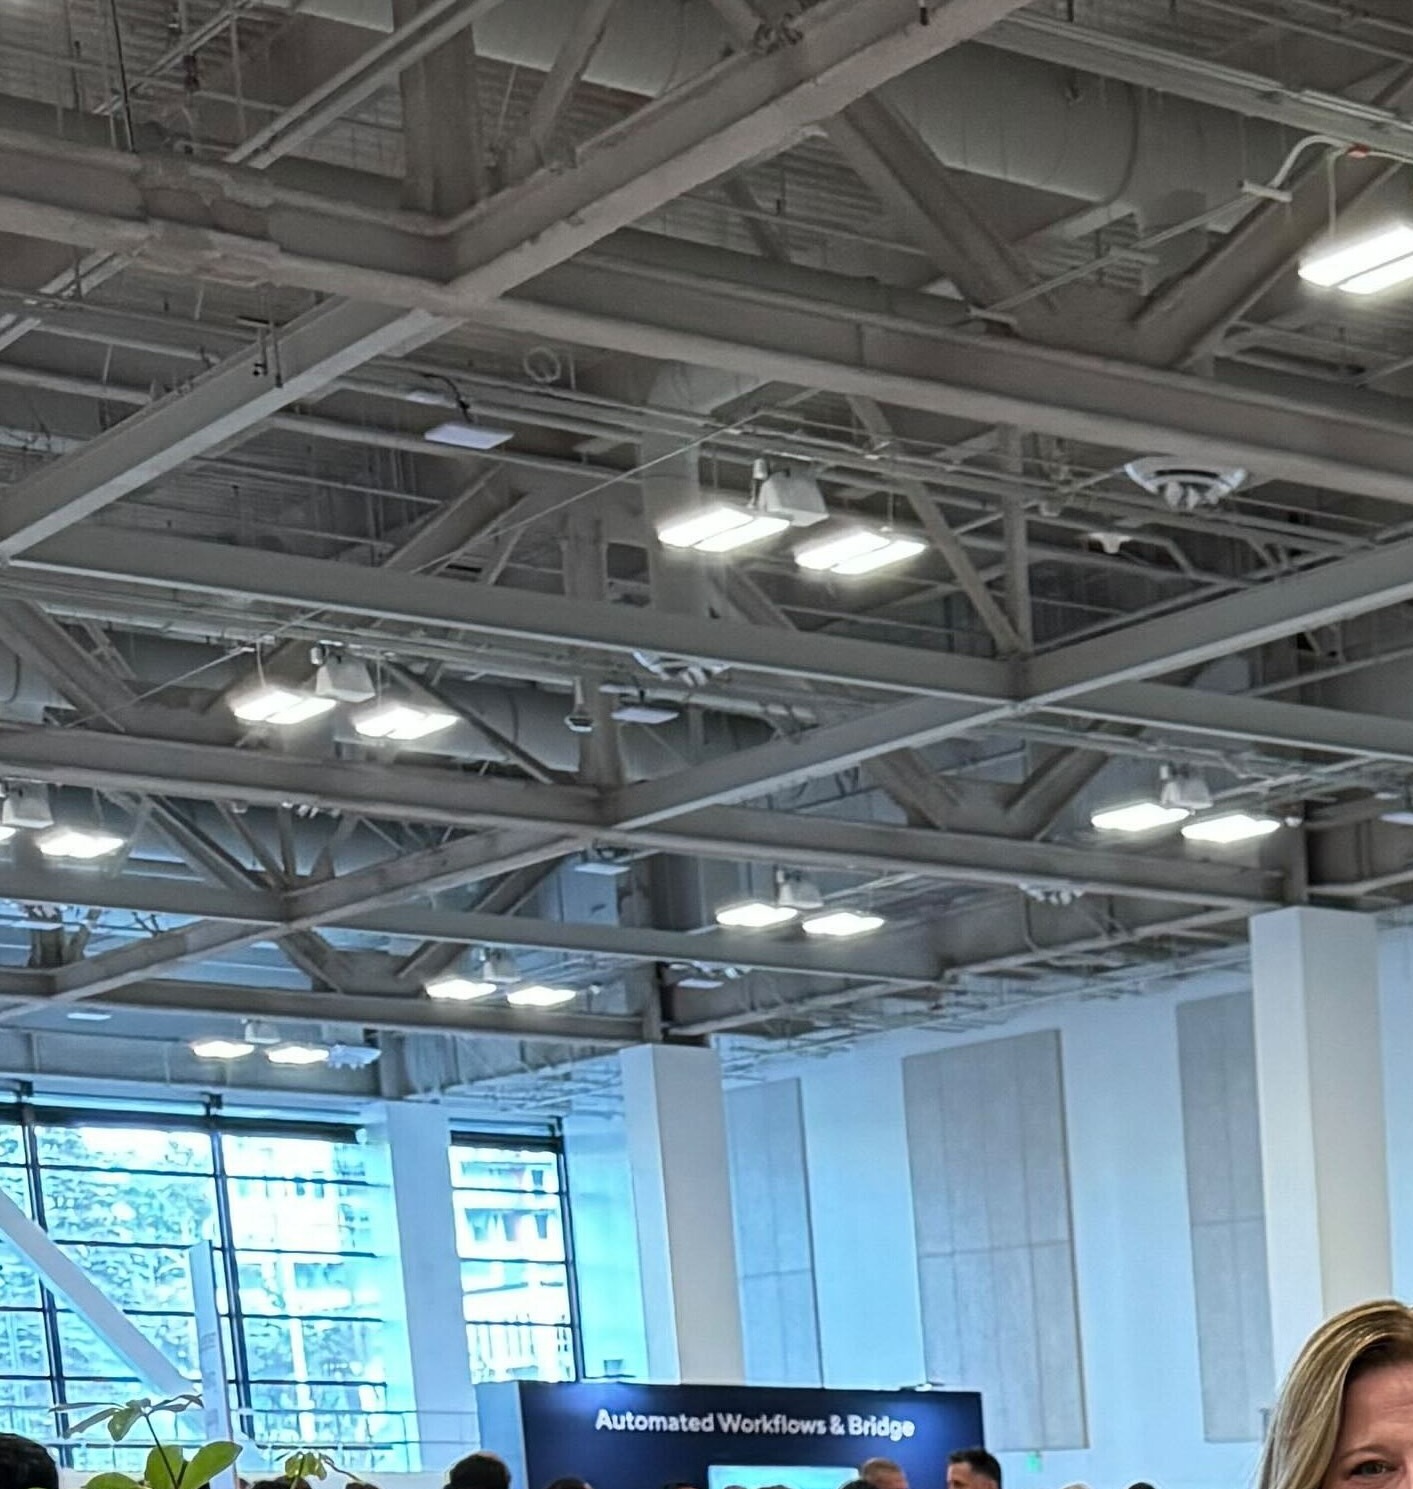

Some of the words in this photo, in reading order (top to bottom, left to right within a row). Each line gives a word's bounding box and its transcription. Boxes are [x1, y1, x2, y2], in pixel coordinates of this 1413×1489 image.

[595, 1409, 714, 1432] Automated
[715, 1413, 827, 1435] Workflows
[829, 1414, 845, 1436] &
[847, 1414, 915, 1442] Bridge
